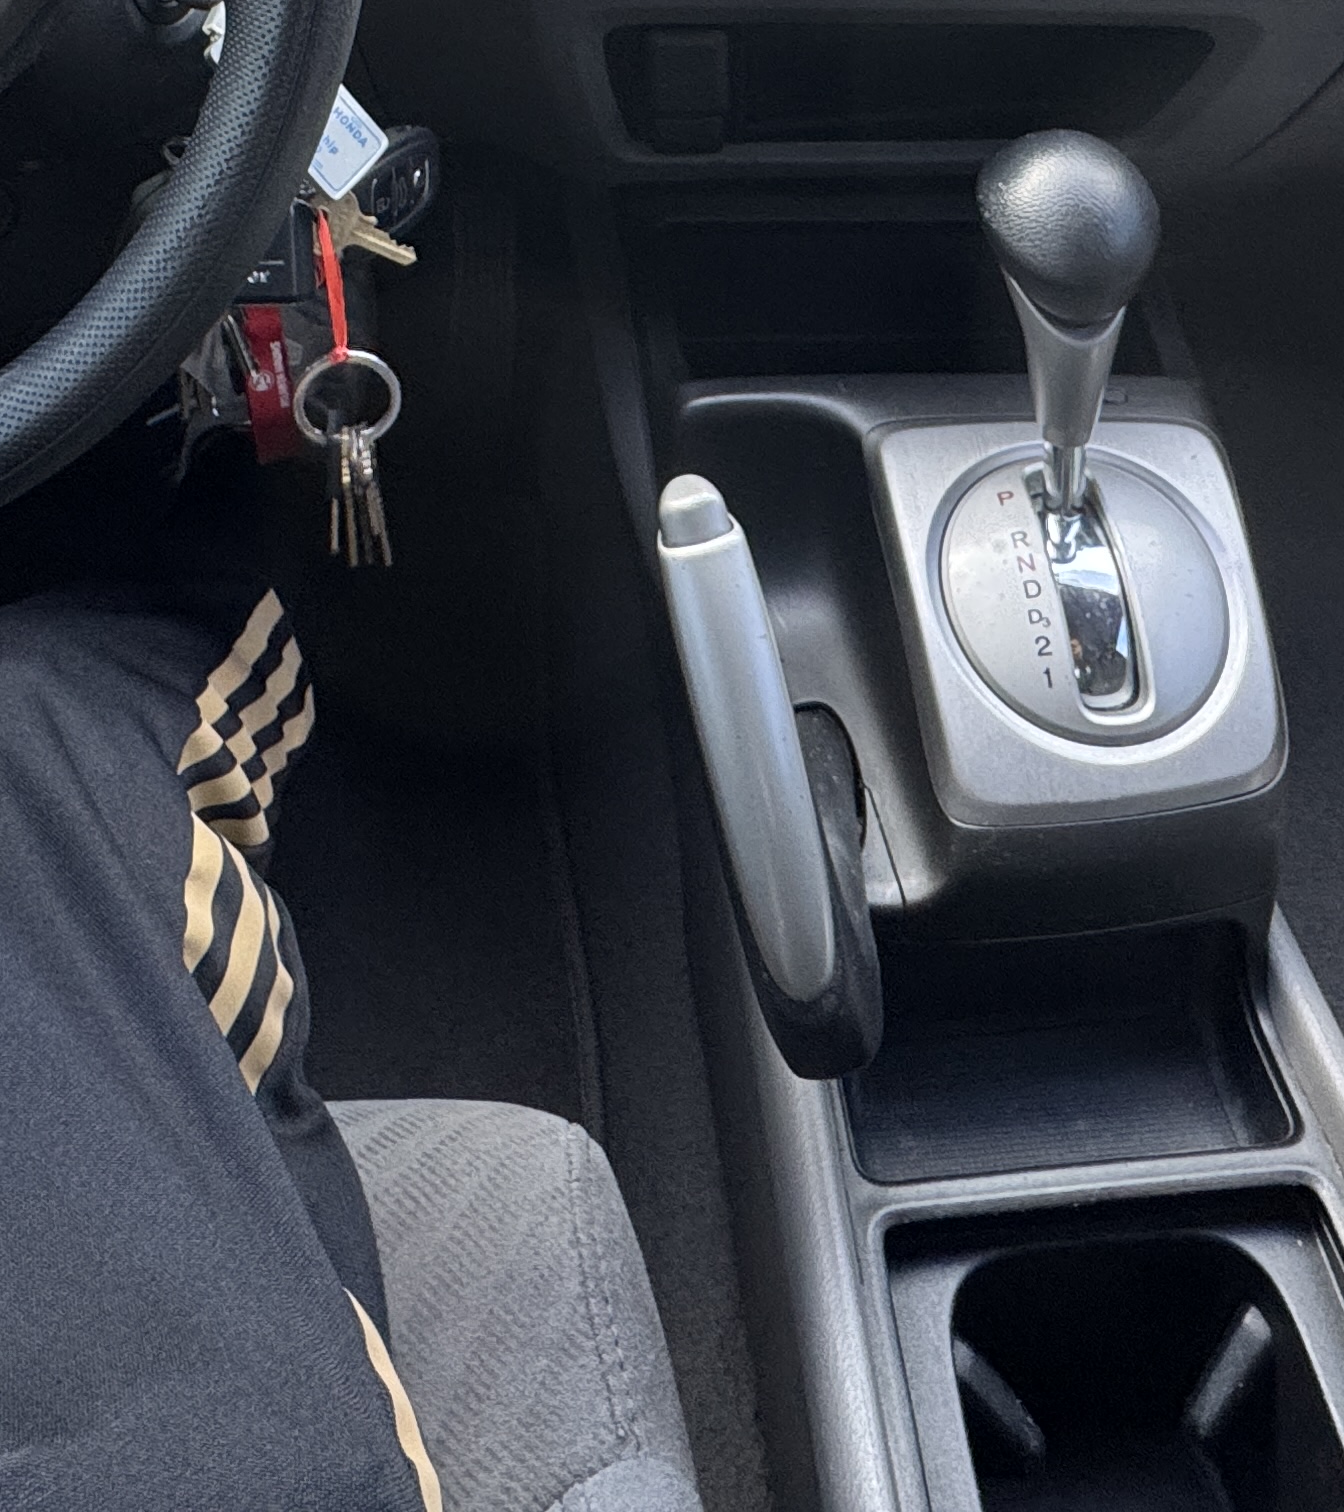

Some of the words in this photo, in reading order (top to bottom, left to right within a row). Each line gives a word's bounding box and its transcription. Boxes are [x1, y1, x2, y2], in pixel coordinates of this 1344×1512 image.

[333, 106, 368, 149] HONDA
[996, 491, 1014, 506] P
[1011, 530, 1030, 548] R
[1017, 554, 1036, 573] N
[1023, 580, 1042, 599] D
[1035, 635, 1053, 656] 2
[1043, 668, 1053, 689] 1
